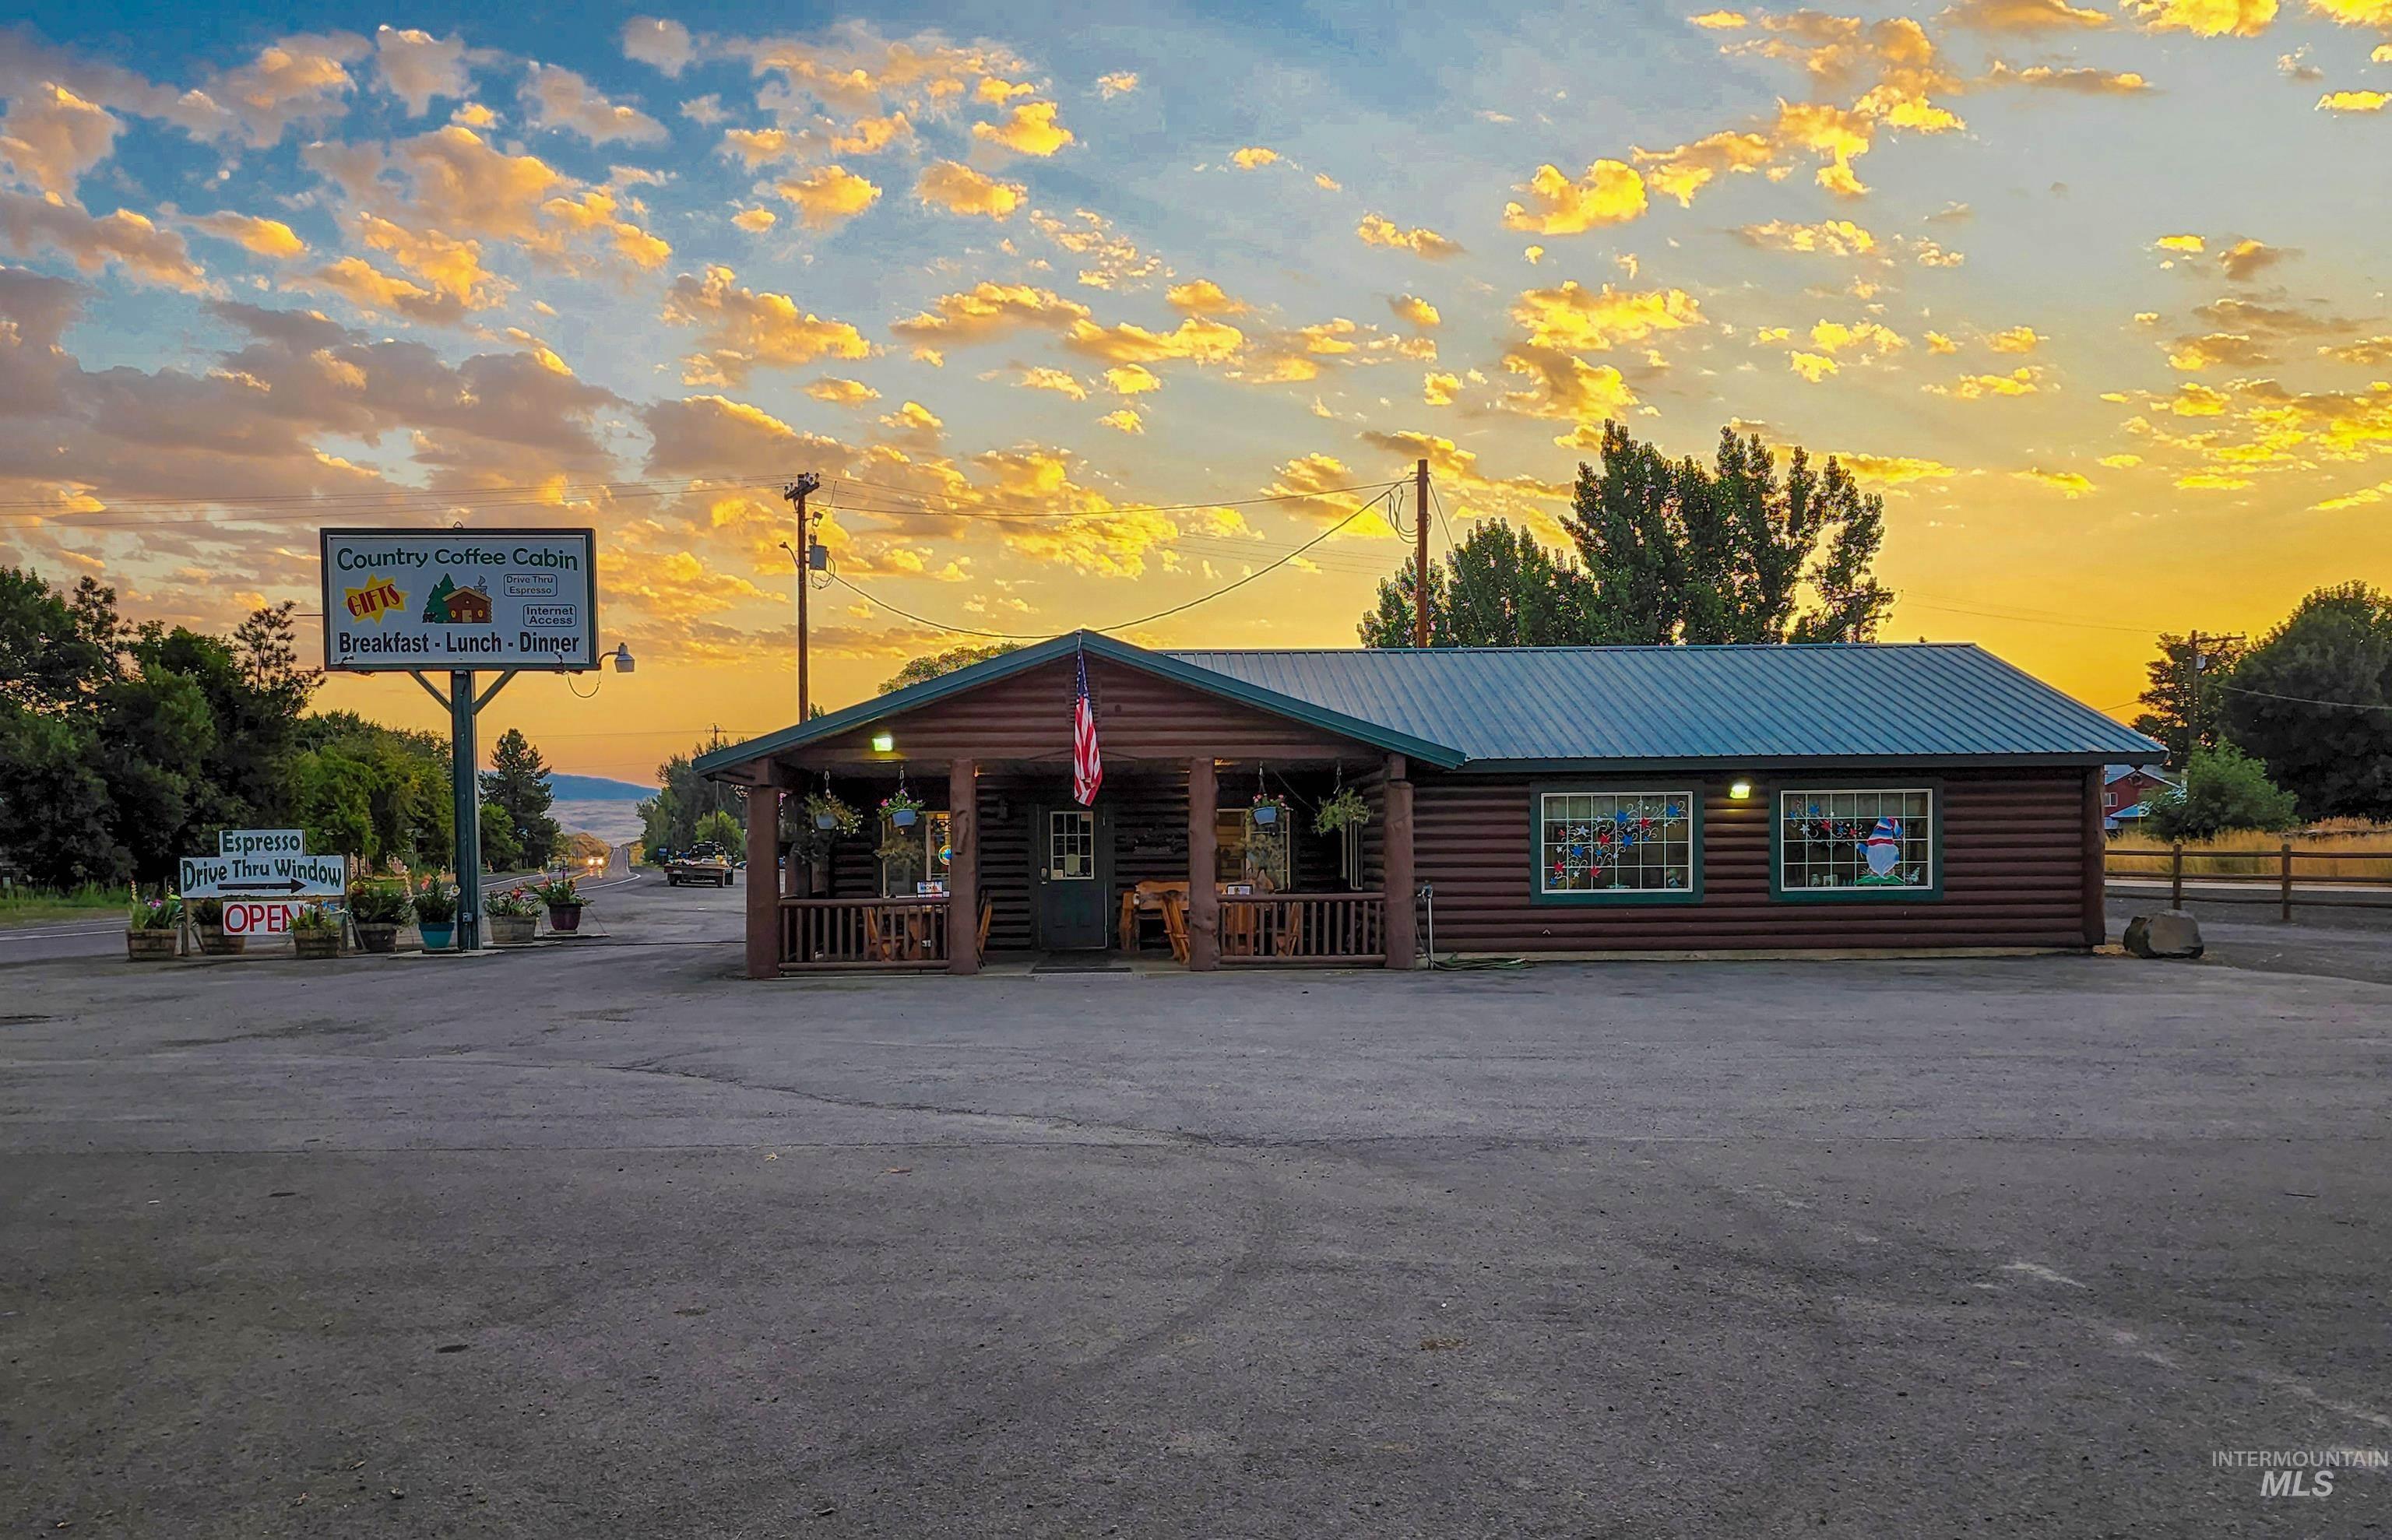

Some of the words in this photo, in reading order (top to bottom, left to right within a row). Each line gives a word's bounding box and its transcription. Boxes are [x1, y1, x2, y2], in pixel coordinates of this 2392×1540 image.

[337, 547, 428, 571] Country
[434, 547, 507, 565] Coffee
[512, 547, 578, 571] Cabin
[346, 583, 400, 617] GIFTS
[509, 585, 552, 595] Espresso
[526, 607, 574, 615] Internet
[529, 615, 573, 624] Access
[339, 631, 429, 652] Breakfast
[446, 631, 501, 652] Lunch
[519, 631, 579, 652] Dinner
[223, 831, 301, 856] Espresso
[183, 860, 227, 892] Drive
[232, 859, 269, 877] Thru
[275, 859, 342, 888] Window
